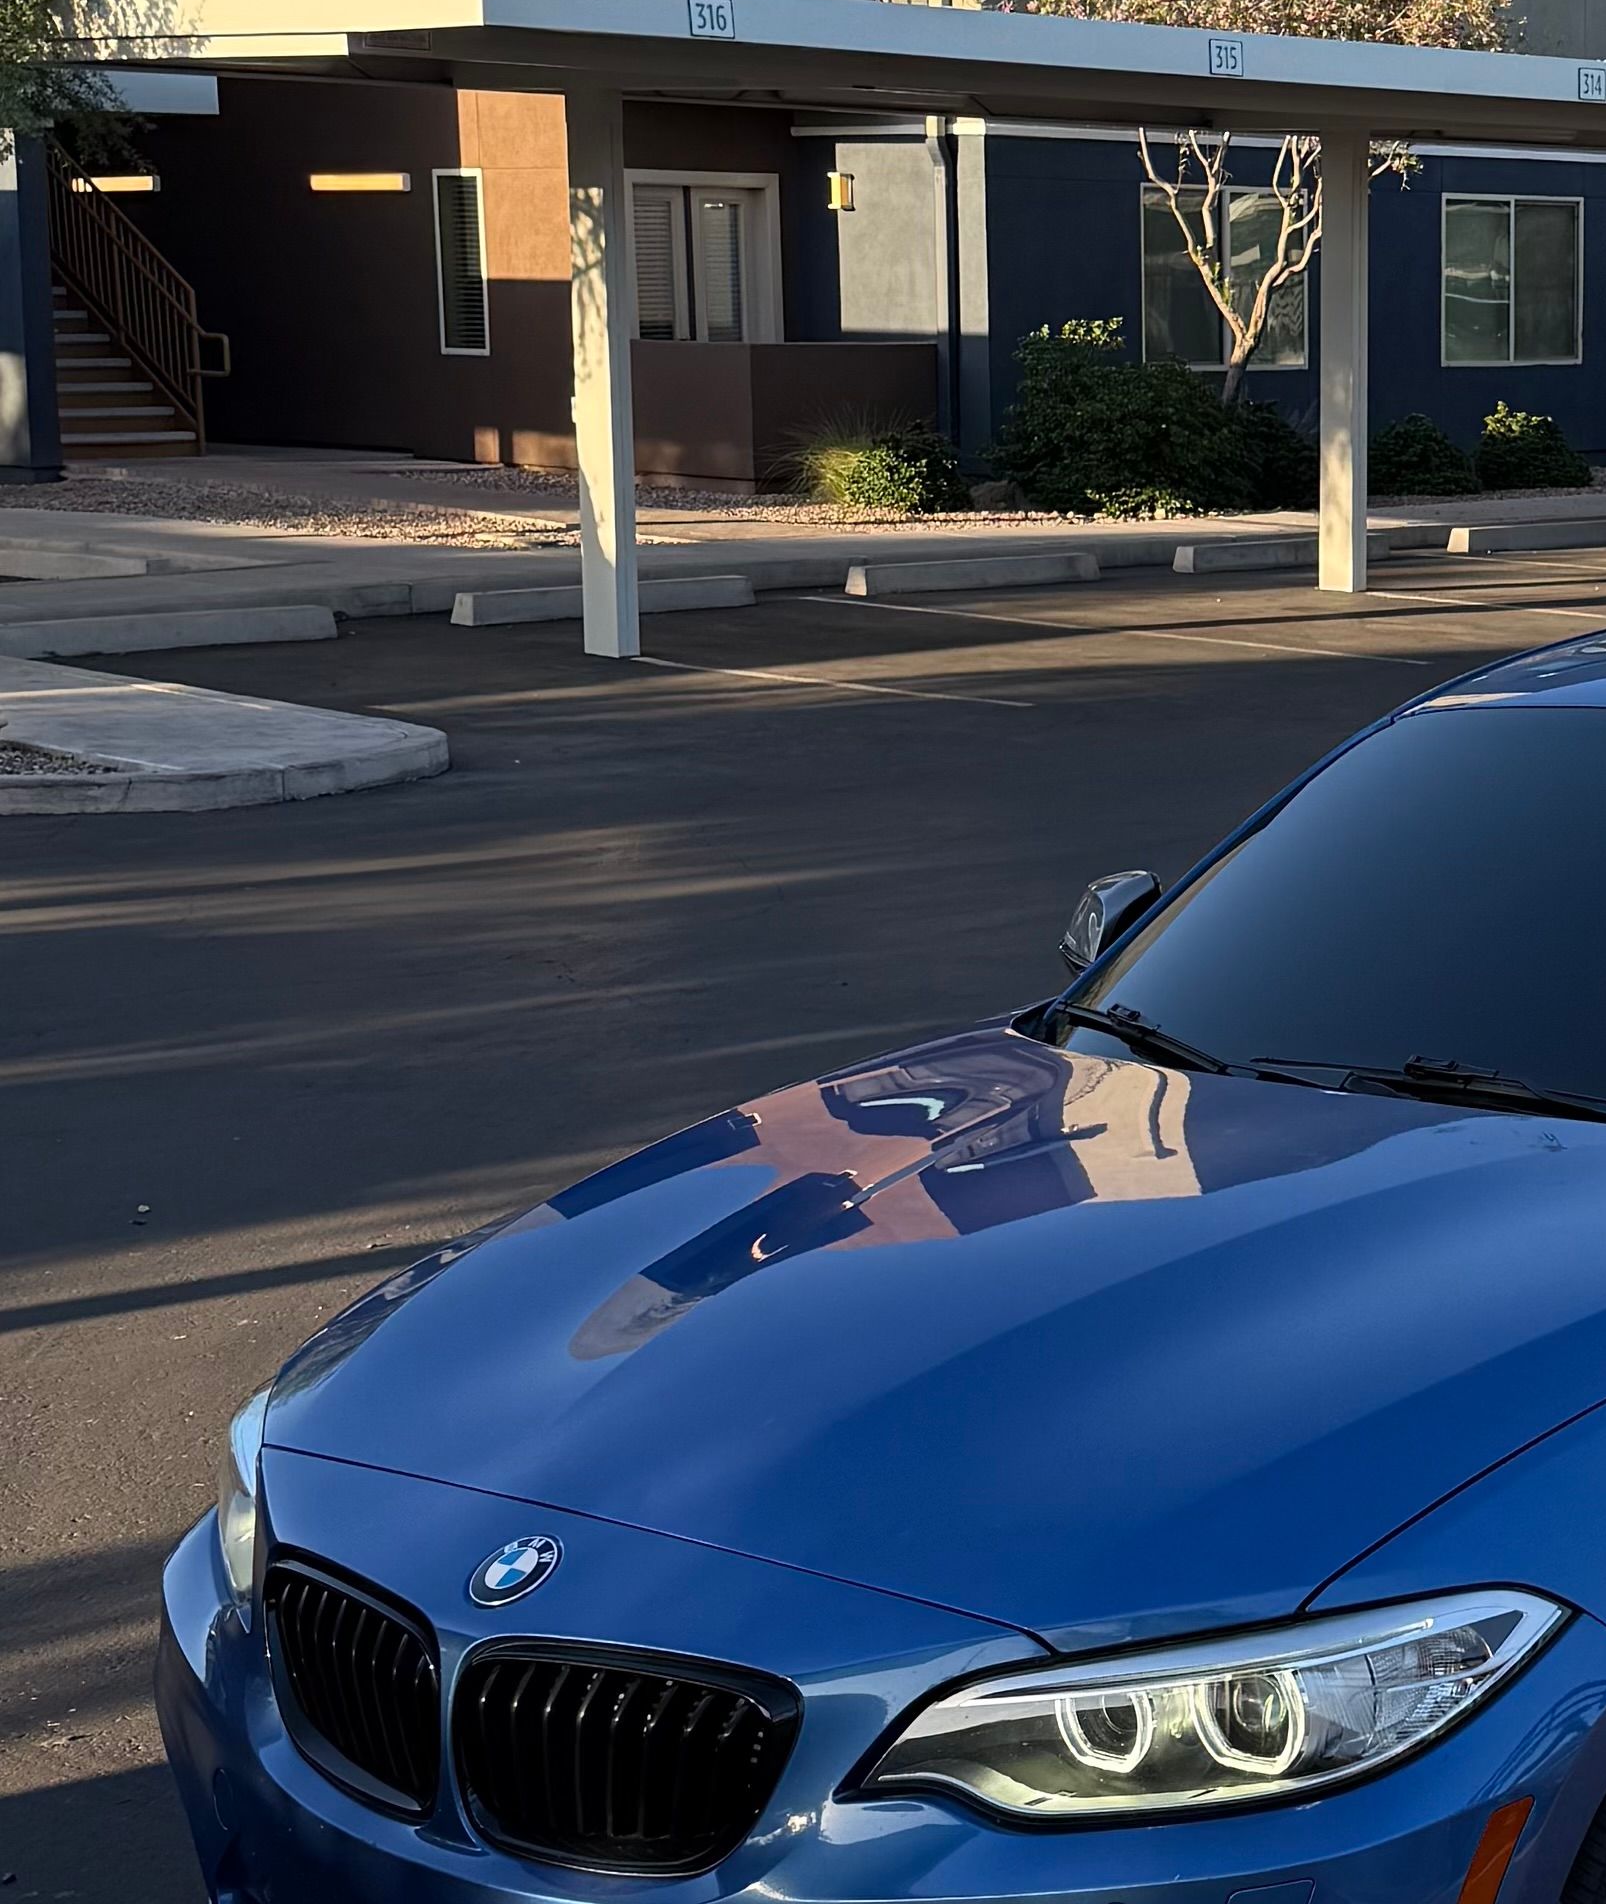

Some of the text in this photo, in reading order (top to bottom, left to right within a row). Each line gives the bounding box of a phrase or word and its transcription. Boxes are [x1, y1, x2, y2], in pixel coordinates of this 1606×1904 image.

[695, 2, 728, 32] 316
[1215, 45, 1237, 70] 315
[1583, 73, 1602, 96] 314
